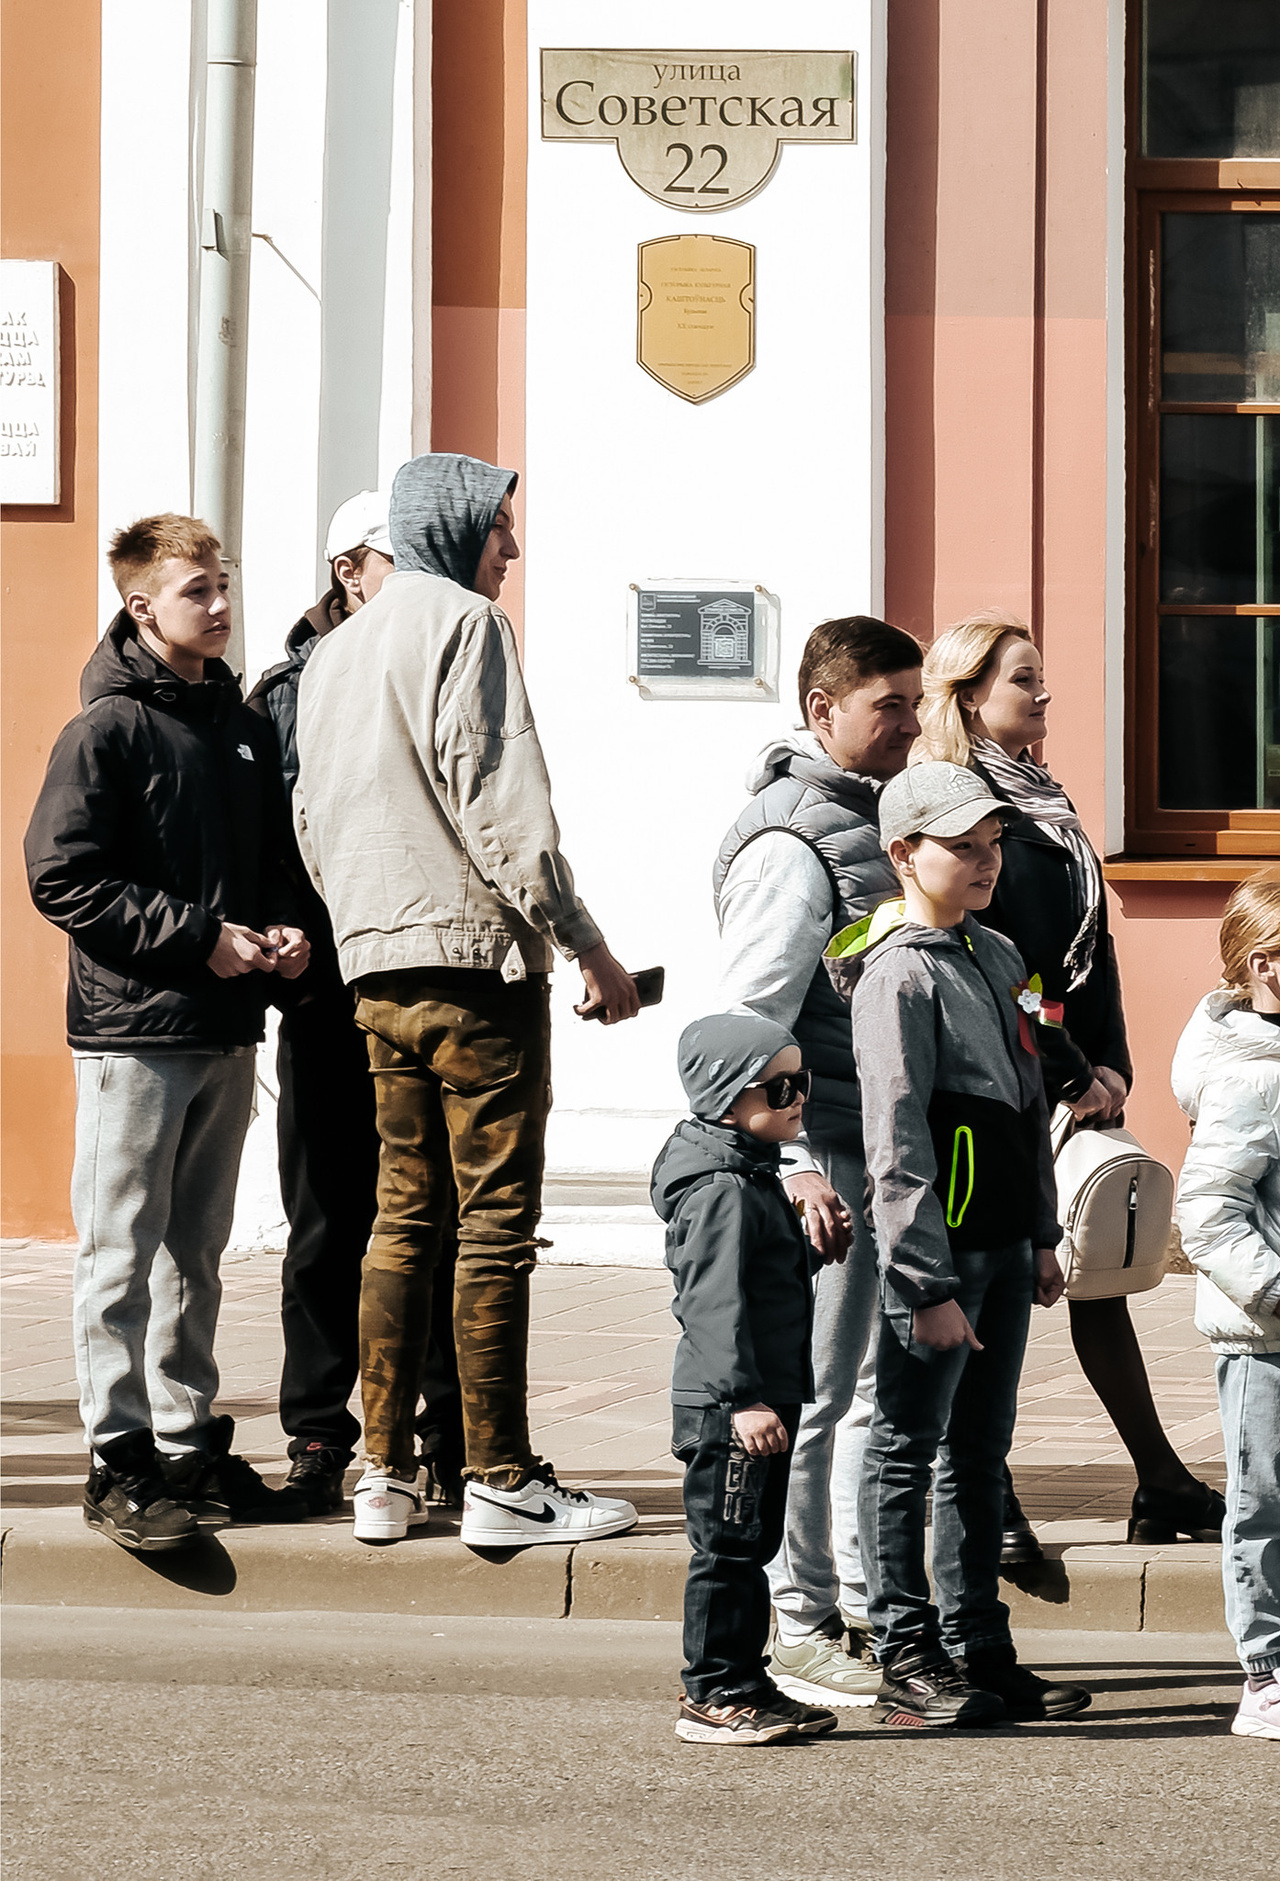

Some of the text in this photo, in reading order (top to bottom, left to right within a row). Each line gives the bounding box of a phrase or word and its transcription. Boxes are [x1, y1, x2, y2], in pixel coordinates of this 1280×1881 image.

[652, 61, 742, 88] улица
[555, 80, 840, 127] Советская
[663, 142, 730, 195] 22
